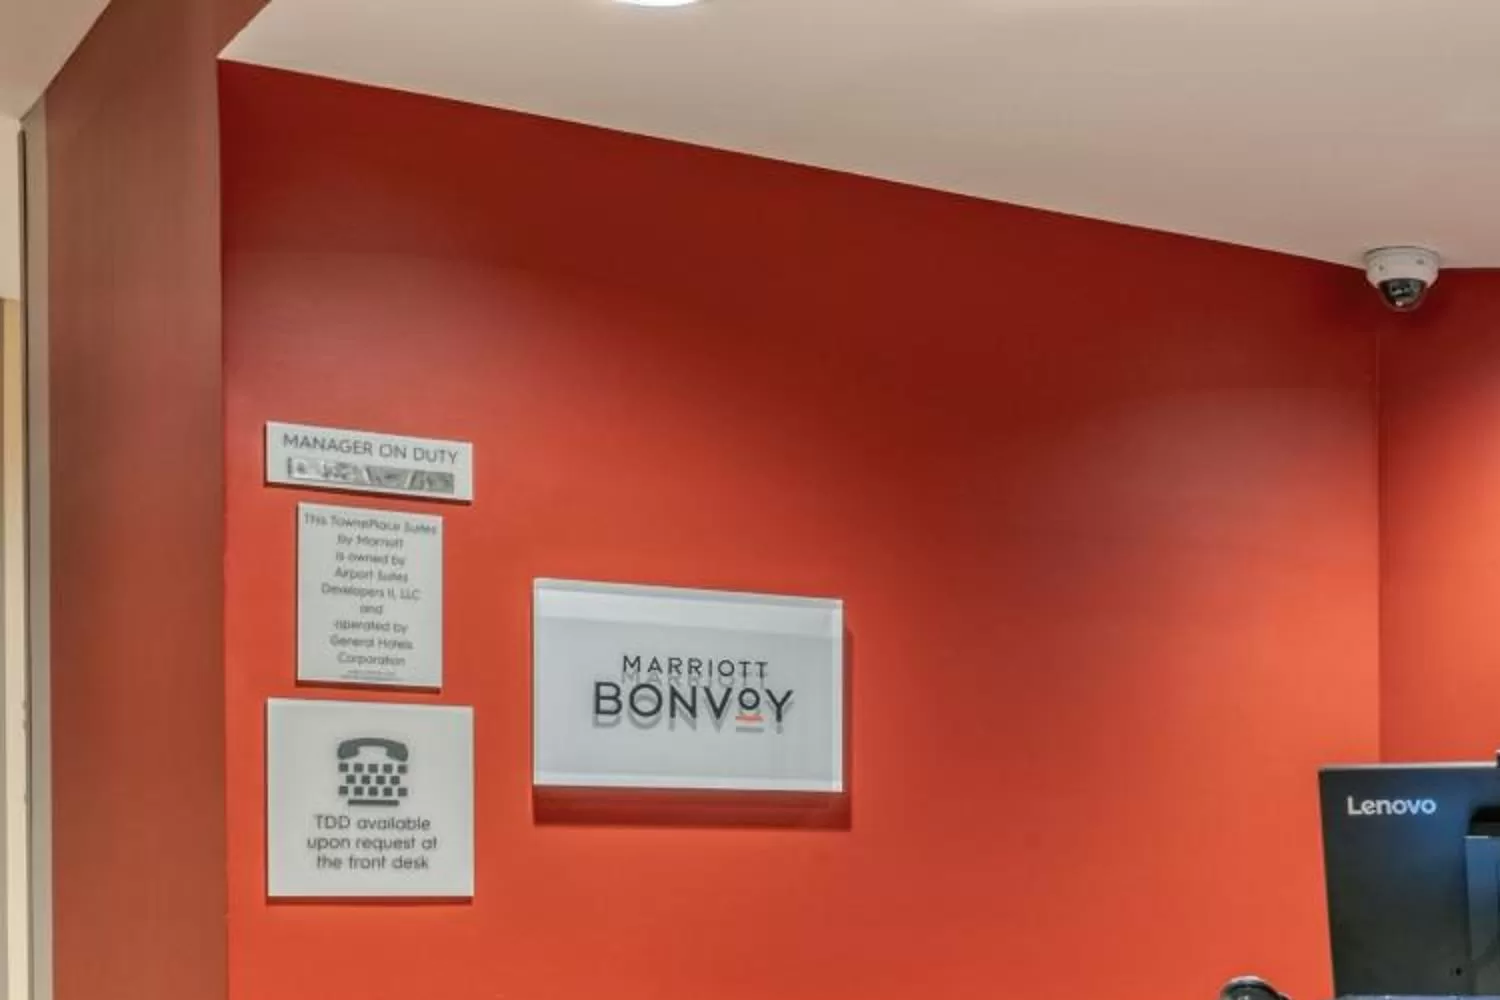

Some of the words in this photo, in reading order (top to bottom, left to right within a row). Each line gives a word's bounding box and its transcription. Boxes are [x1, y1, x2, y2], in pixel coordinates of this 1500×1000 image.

[283, 433, 373, 456] MANAGER
[379, 444, 407, 459] ON
[413, 447, 459, 464] DUTY
[622, 655, 769, 680] MARRIOTT
[593, 681, 794, 723] BONVOY
[1347, 795, 1436, 816] Lenovo
[315, 814, 351, 830] TDD
[356, 815, 432, 831] available
[306, 836, 351, 852] upon
[355, 836, 416, 853] request
[421, 837, 438, 850] at
[316, 854, 342, 870] the
[349, 855, 386, 870] front
[391, 856, 429, 870] desk
